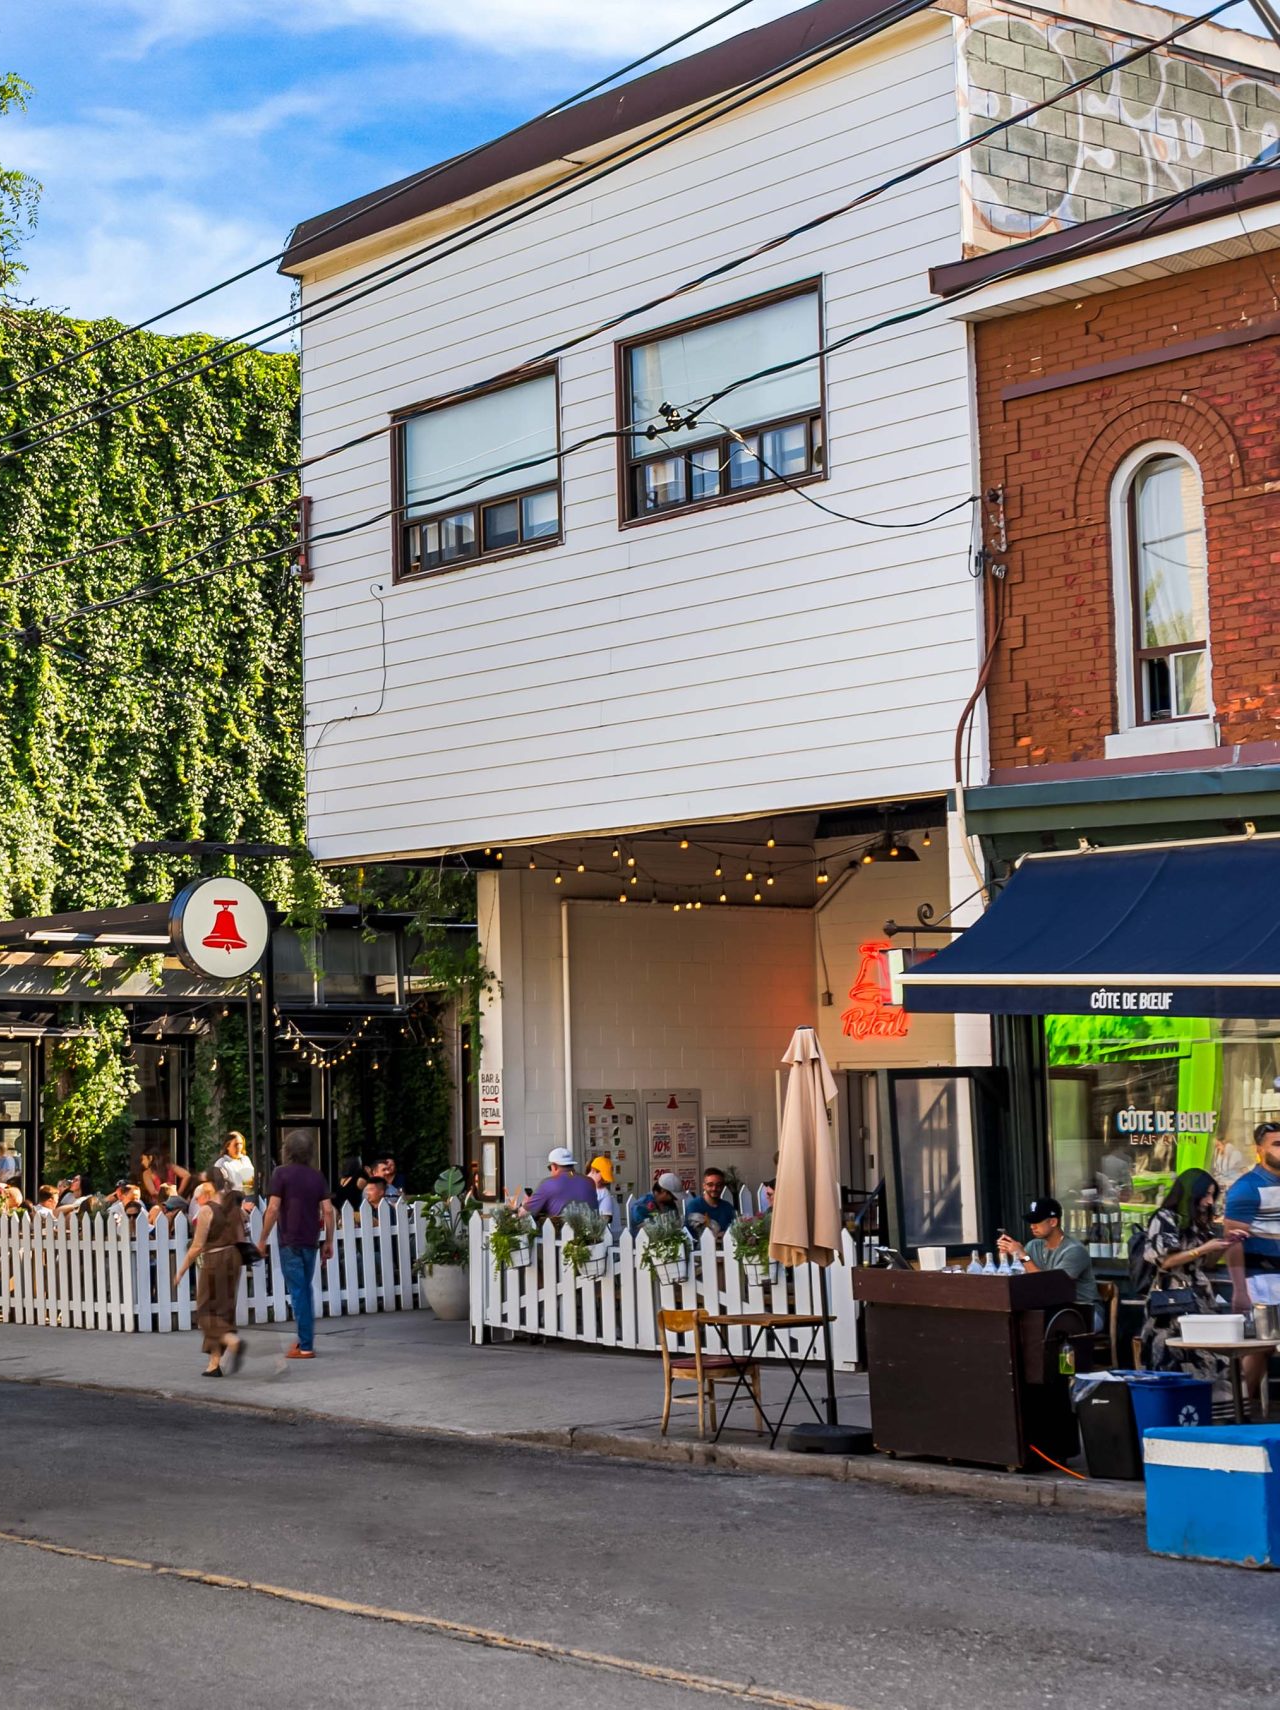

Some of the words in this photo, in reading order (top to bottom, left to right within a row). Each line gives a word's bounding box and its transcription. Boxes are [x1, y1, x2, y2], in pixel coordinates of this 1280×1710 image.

[1091, 988, 1121, 1009] CÔTE
[1122, 992, 1138, 1009] DE
[1139, 992, 1174, 1010] BŒUF
[840, 1007, 908, 1040] Retail
[481, 1073, 494, 1083] BAR
[495, 1073, 500, 1083] &
[481, 1085, 500, 1095] FOOD
[481, 1108, 501, 1118] RETAIL
[1118, 1105, 1154, 1132] CÔTE
[1156, 1110, 1175, 1132] DE
[1177, 1110, 1217, 1133] BŒUF
